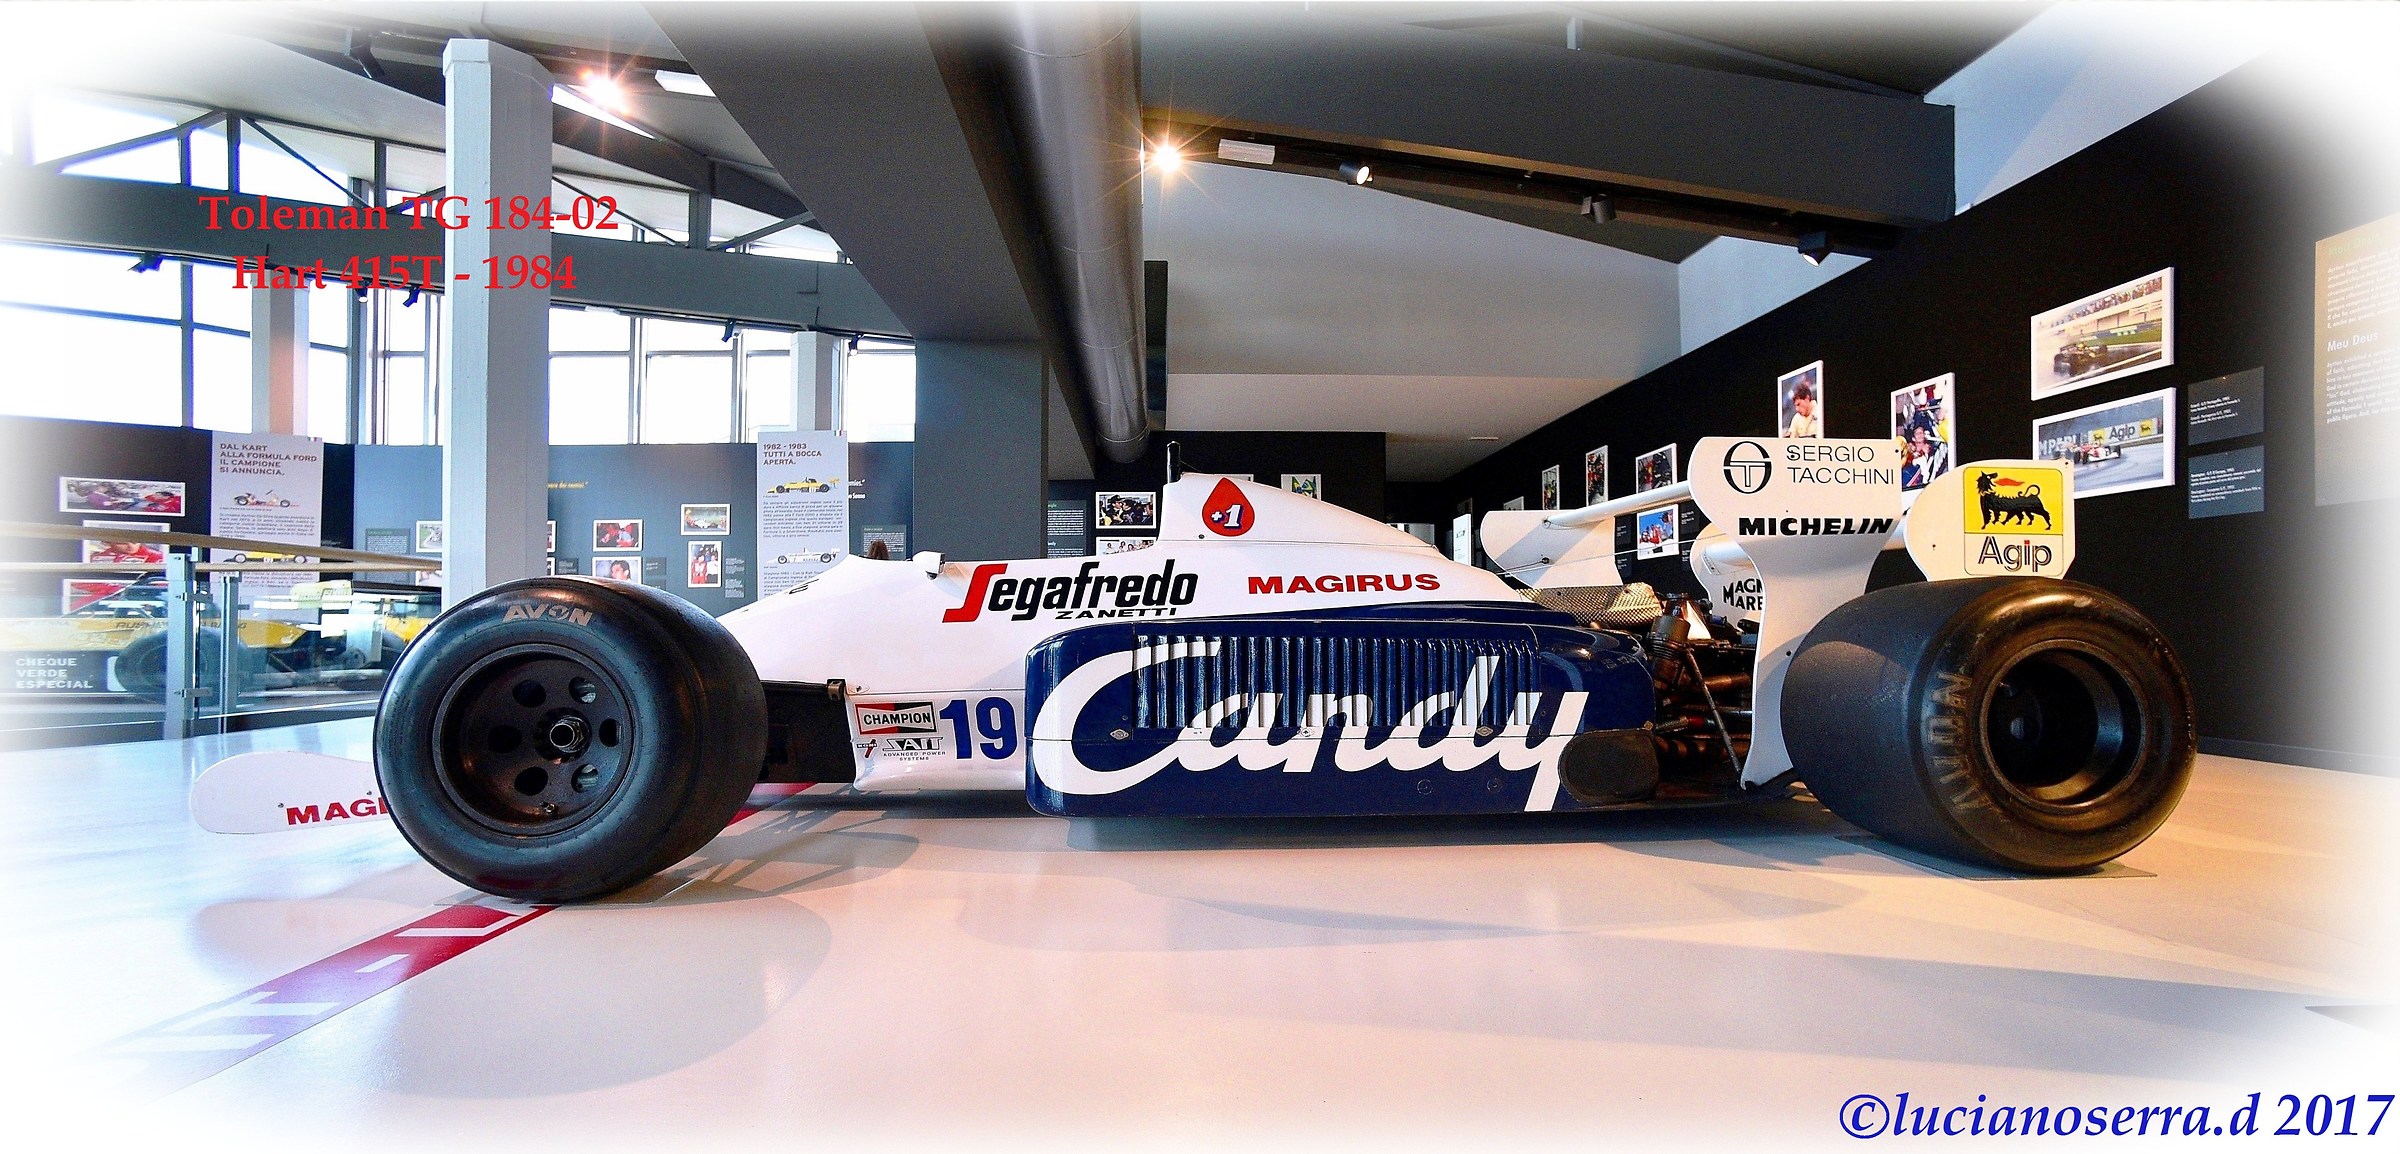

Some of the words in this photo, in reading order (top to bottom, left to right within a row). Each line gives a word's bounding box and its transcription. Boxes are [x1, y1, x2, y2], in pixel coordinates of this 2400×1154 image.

[2327, 340, 2349, 352] Meu
[2352, 332, 2379, 346] Deus
[2109, 424, 2136, 443] Agip
[242, 444, 268, 452] KART
[247, 452, 292, 461] FORMULA
[1786, 445, 1875, 463] SERGIO
[231, 459, 281, 468] CAMPIONE
[232, 467, 285, 476] ANNUNCIA.
[1786, 466, 1894, 485] TACCHINI
[1738, 517, 1894, 536] MICHELIN
[1978, 536, 2052, 572] Agip
[941, 558, 1199, 623] Segafredo
[1247, 572, 1441, 595] MAGIRUS
[502, 603, 593, 626] AVON
[1054, 607, 1177, 620] ZANETTI
[15, 657, 78, 668] CHEQUE
[16, 669, 68, 678] VERDE
[16, 680, 94, 689] ESPECIAL
[863, 712, 931, 725] CHAMPION
[1032, 641, 1590, 812] Candy
[939, 697, 1018, 760] 19
[1928, 670, 1992, 812] AVON
